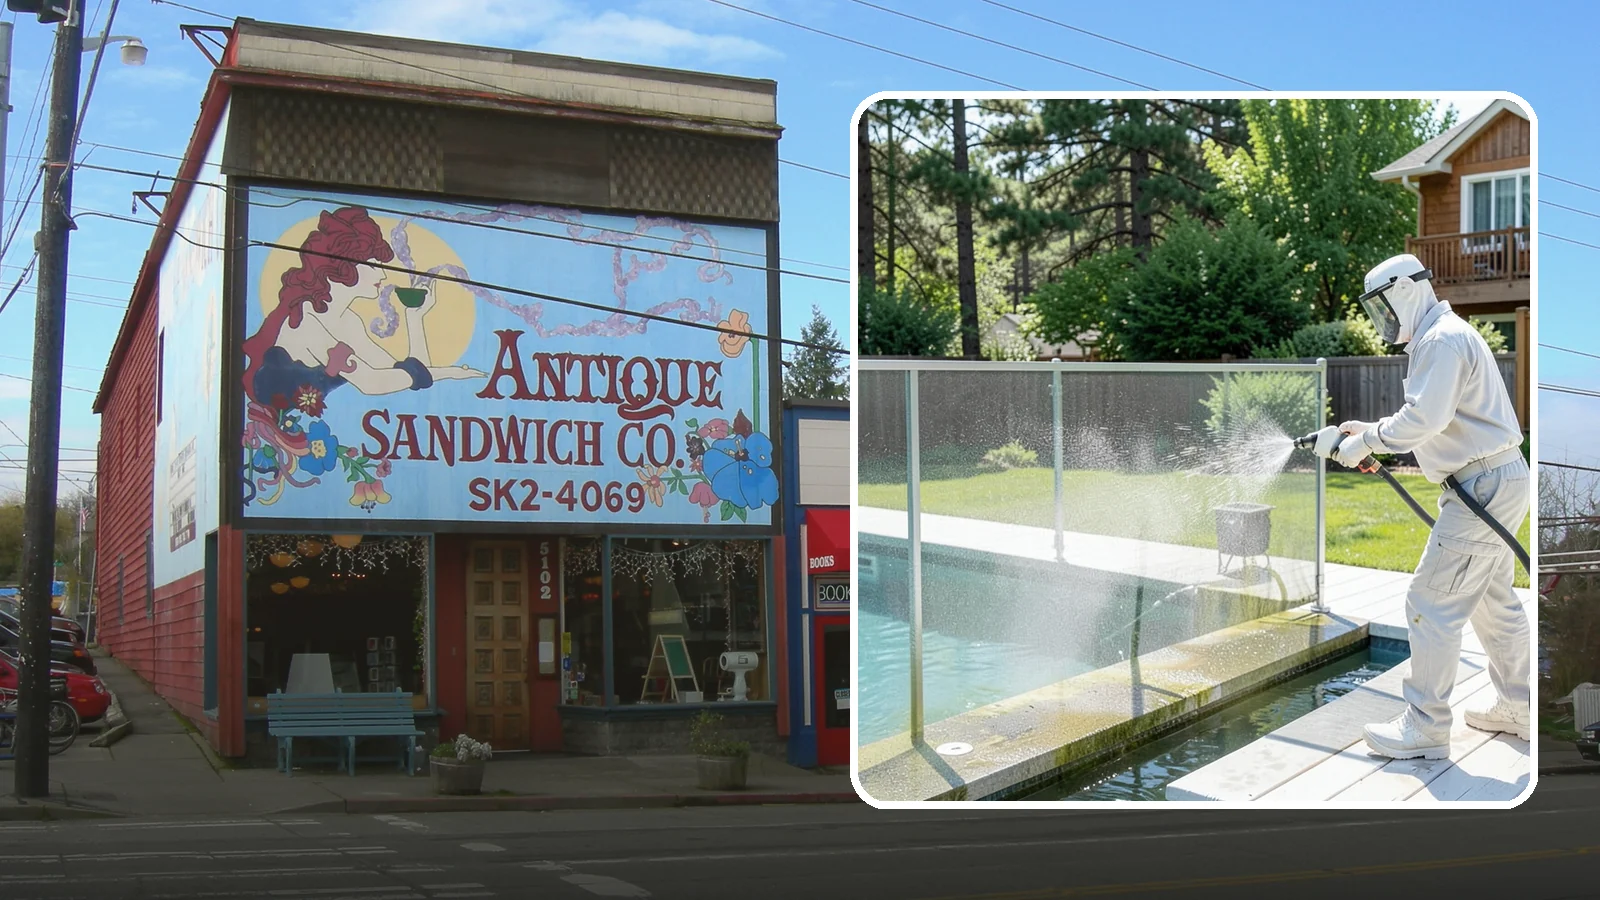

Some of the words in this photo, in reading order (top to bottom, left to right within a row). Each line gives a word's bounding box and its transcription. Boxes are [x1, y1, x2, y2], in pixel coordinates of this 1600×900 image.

[476, 329, 724, 420] ANTIQUE
[362, 408, 604, 467] SANDWICH
[617, 421, 685, 469] CO.
[468, 477, 645, 513] SK2-4069
[540, 541, 551, 600] 5102
[809, 555, 835, 569] BOOKS
